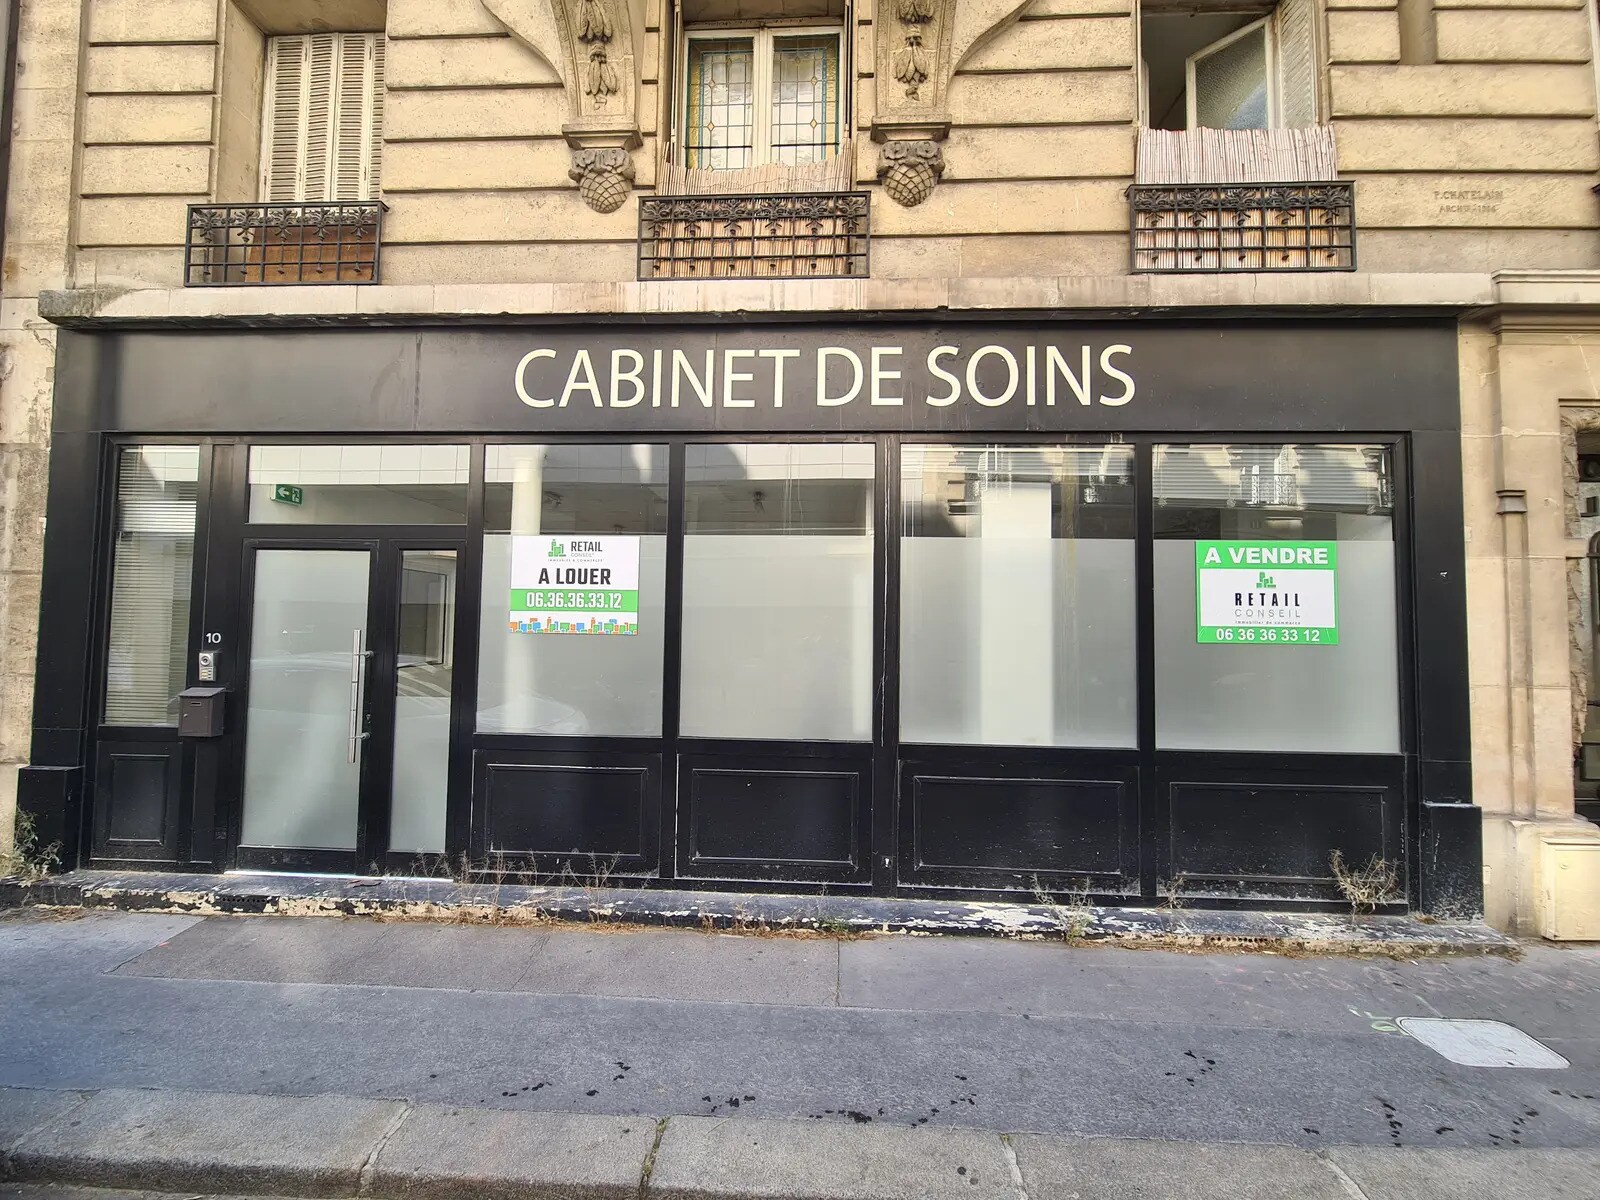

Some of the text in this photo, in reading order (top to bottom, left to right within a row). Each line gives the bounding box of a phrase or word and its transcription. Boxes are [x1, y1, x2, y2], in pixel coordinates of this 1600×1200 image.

[514, 344, 1136, 408] CABINET DE SOINS
[571, 541, 603, 552] RETAIL
[1204, 547, 1329, 565] A VENDRE
[538, 568, 611, 585] A LOUER
[526, 592, 622, 609] 06.36.36.33.12
[1234, 592, 1300, 607] RETAIL
[1234, 608, 1301, 618] CONSEIL
[206, 632, 222, 644] 10
[1216, 628, 1320, 642] 06 36 36 33 12
